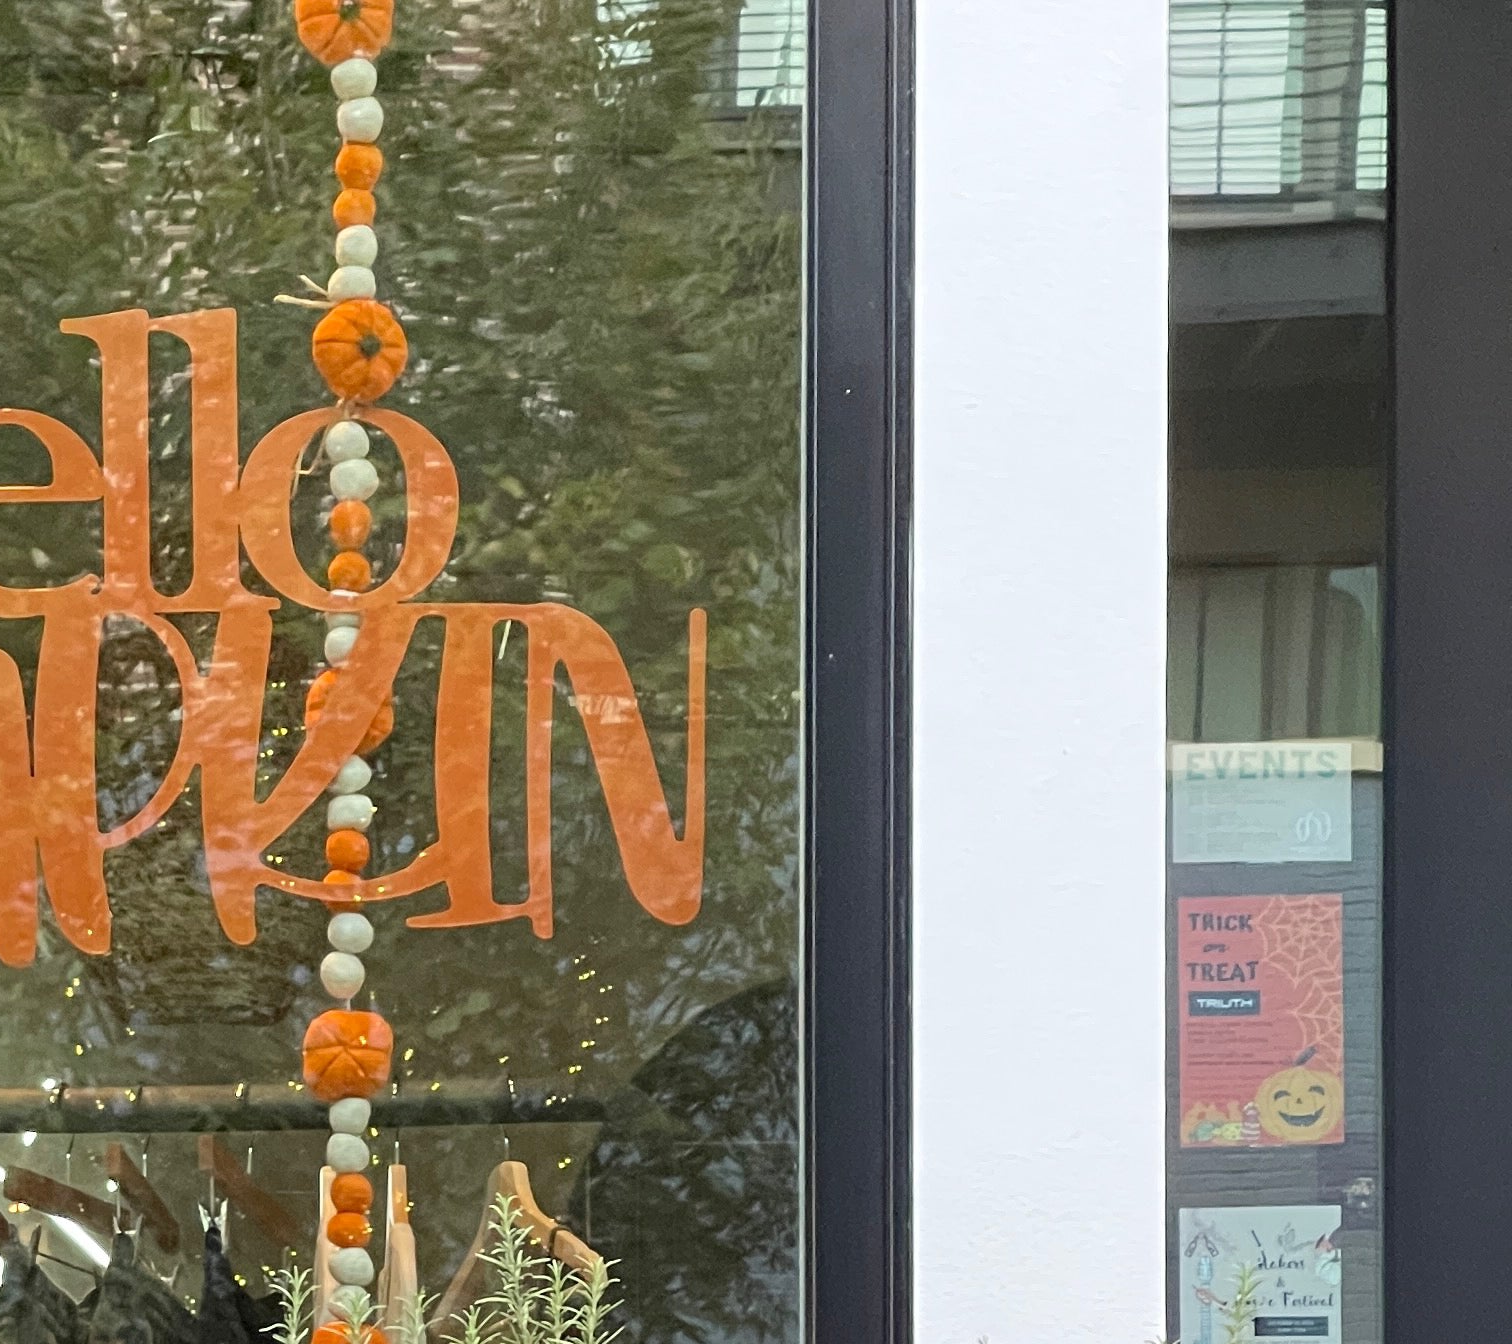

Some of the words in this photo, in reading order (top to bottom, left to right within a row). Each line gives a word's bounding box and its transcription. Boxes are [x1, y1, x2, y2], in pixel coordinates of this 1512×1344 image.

[1186, 750, 1338, 780] EVENTS
[1188, 912, 1253, 932] TRICK
[1186, 960, 1259, 982] TREAT
[1196, 998, 1253, 1009] TRUTH
